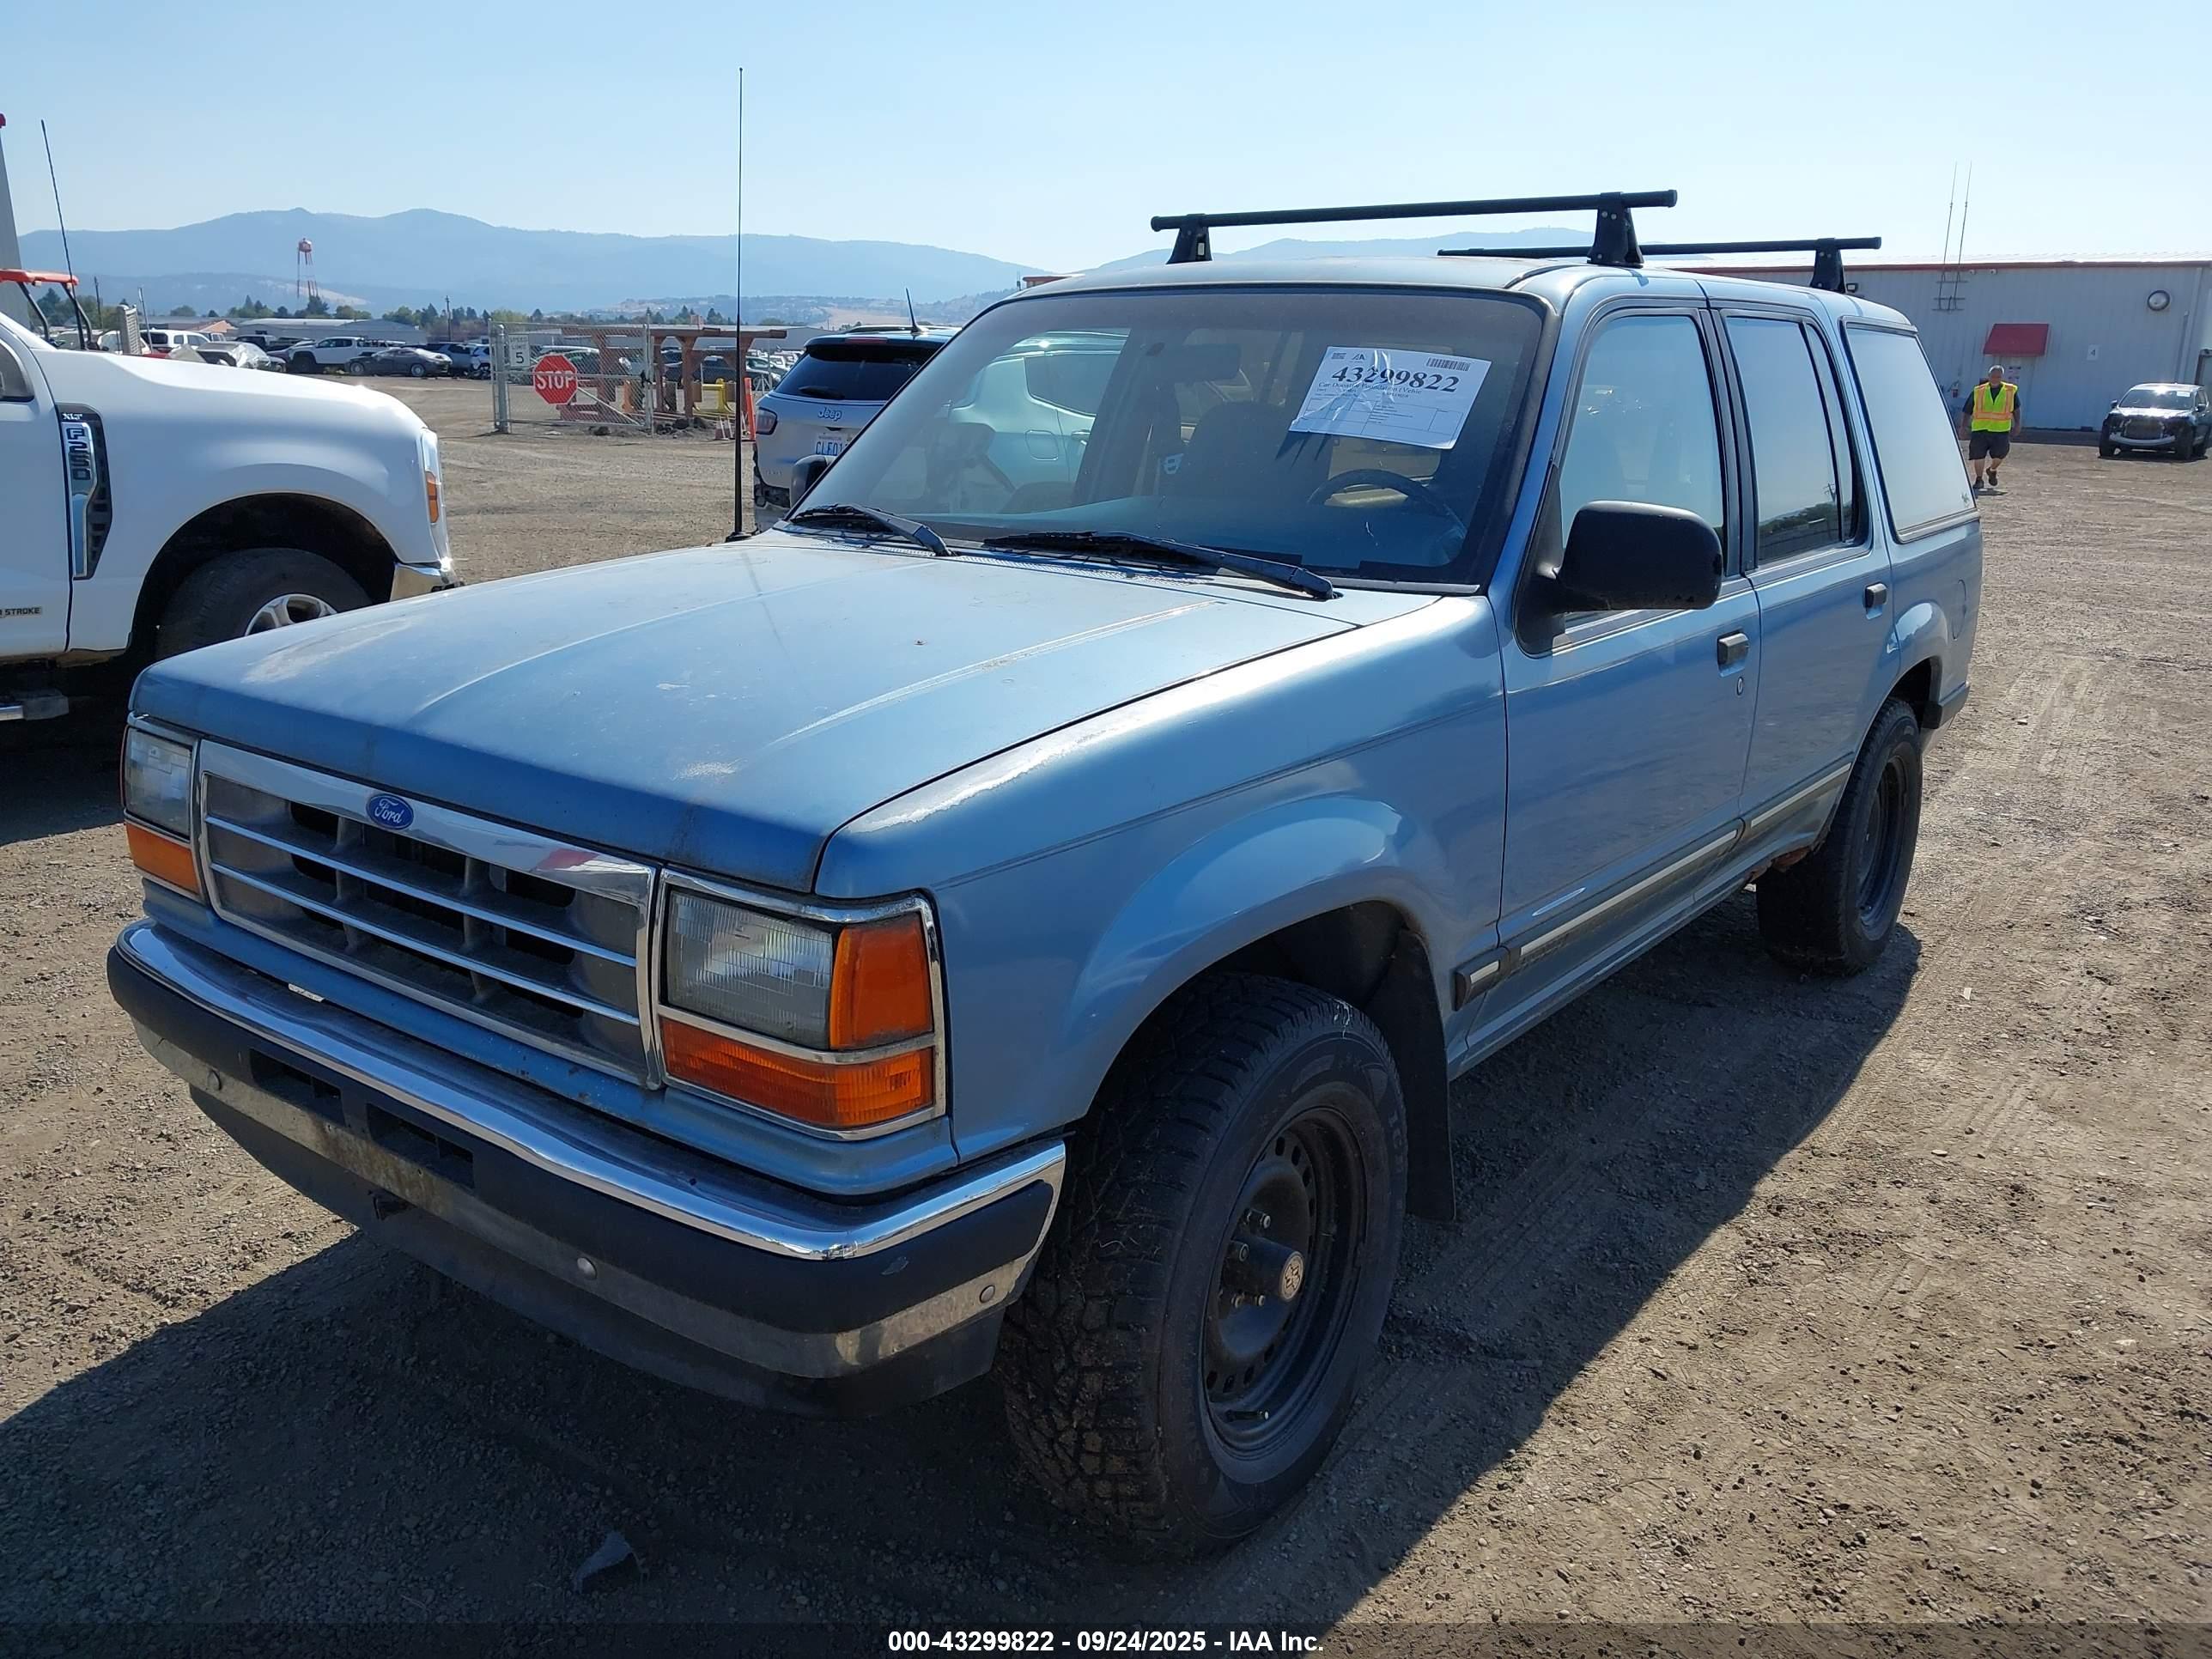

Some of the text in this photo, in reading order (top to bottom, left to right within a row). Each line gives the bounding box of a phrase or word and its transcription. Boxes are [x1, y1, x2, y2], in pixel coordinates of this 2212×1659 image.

[515, 351, 525, 364] 5
[536, 370, 574, 390] STOP
[1332, 366, 1460, 392] 43299822
[817, 408, 842, 422] Jeep
[4, 606, 41, 616] STROKE
[374, 798, 404, 823] Ford
